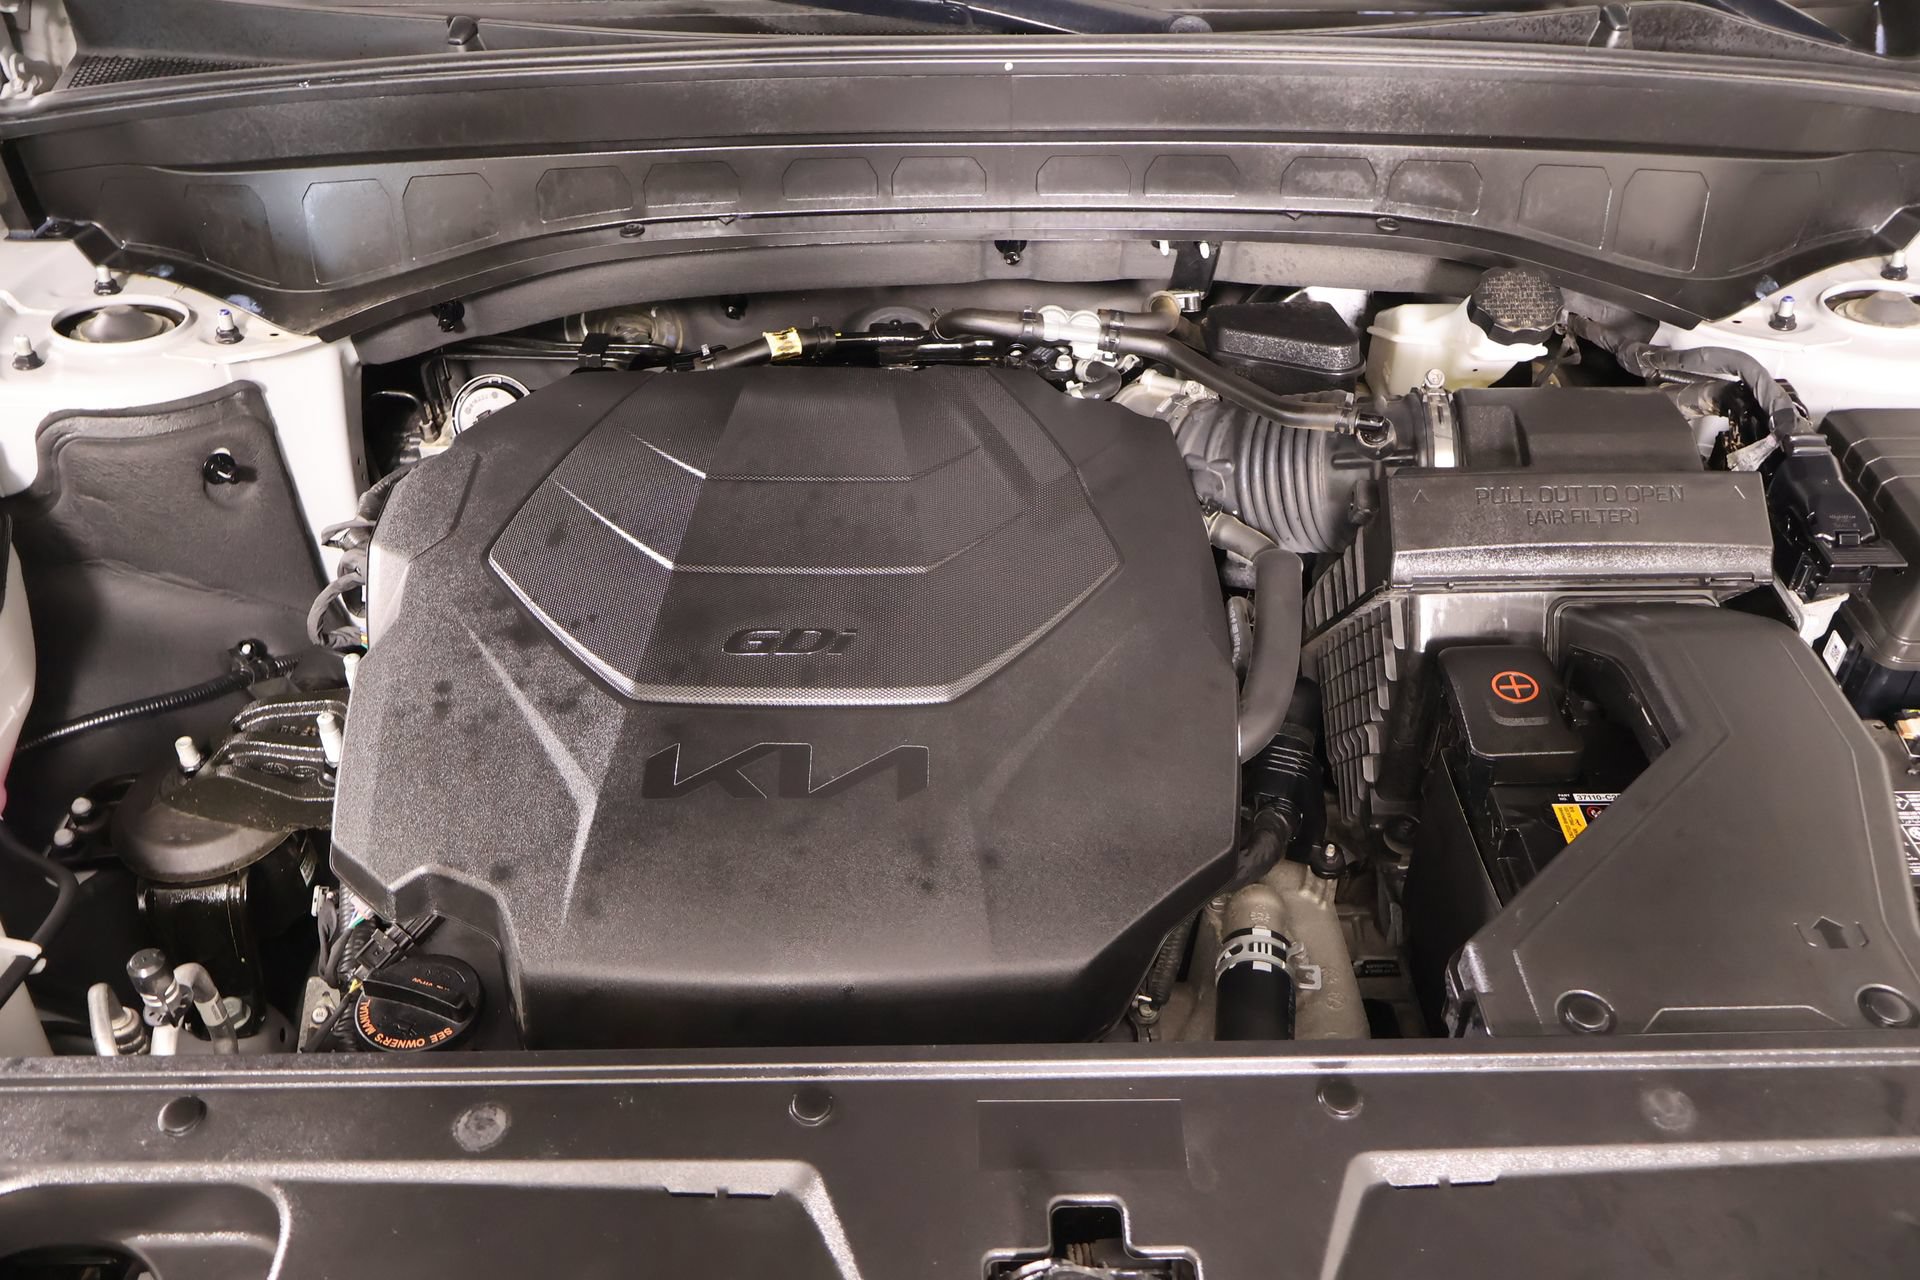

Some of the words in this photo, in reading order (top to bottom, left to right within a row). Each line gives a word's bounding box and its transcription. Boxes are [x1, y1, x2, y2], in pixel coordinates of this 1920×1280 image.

[1475, 485, 1533, 505] PULL
[1539, 485, 1583, 504] OUT
[1588, 485, 1618, 503] TO
[1625, 485, 1684, 503] OPEN
[359, 999, 377, 1036] MANUAL
[374, 1033, 426, 1048] OWNER'S
[430, 1027, 453, 1043] SEE
